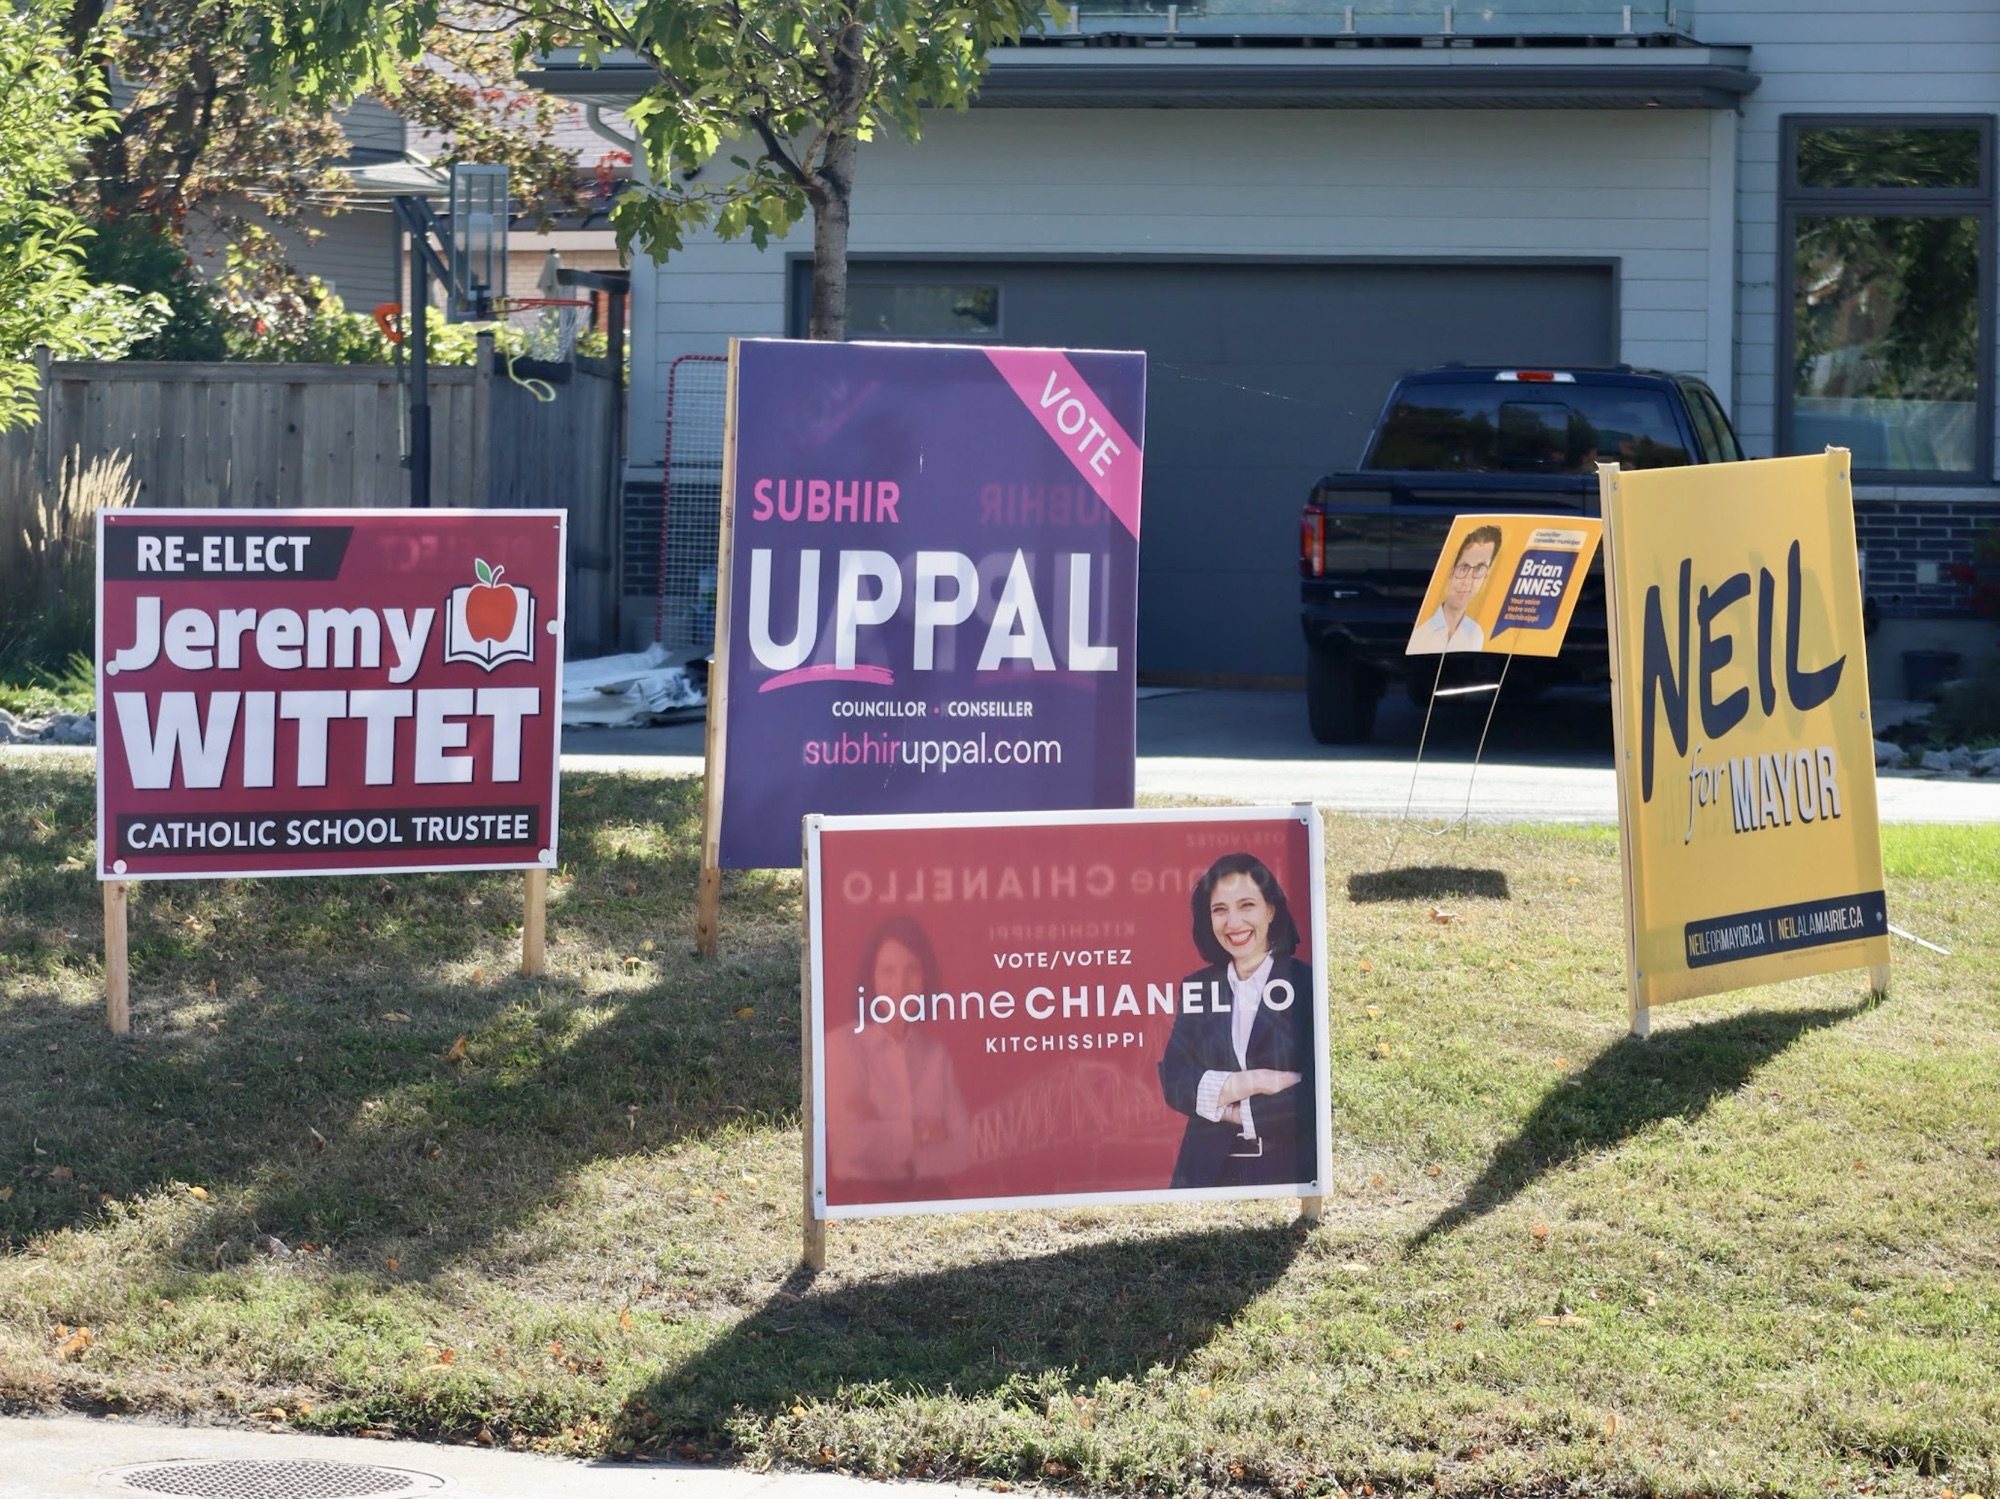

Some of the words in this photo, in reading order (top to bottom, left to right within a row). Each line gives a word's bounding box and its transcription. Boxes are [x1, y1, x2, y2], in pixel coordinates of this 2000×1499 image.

[1040, 370, 1120, 477] VOTE
[753, 478, 900, 523] SUBHIR
[138, 535, 311, 572] RE-ELECT
[1520, 559, 1563, 578] Brian
[749, 548, 1118, 672] UPPAL
[1513, 578, 1563, 598] INNES
[116, 596, 435, 684] Jeremy
[1642, 538, 1847, 803] NEIL
[831, 701, 927, 717] COUNCILLOR
[947, 701, 1033, 717] CONSEILLER
[114, 687, 540, 789] WITTET
[805, 732, 1062, 773] subhiruppal.com
[1685, 742, 1725, 846] for
[1728, 745, 1842, 834] MAYOR
[127, 820, 276, 849] CATHOLIC
[286, 817, 403, 846] SCHOOL
[411, 814, 529, 842] TRUSTEE
[1688, 921, 1766, 957] NEILFORMAYOR.CA
[1777, 905, 1865, 941] NEILALAMAIRIE.CA
[993, 949, 1132, 970] VOTE/VOTEZ
[853, 986, 1015, 1034] joanne
[986, 1032, 1144, 1053] KITCHISSIPPI
